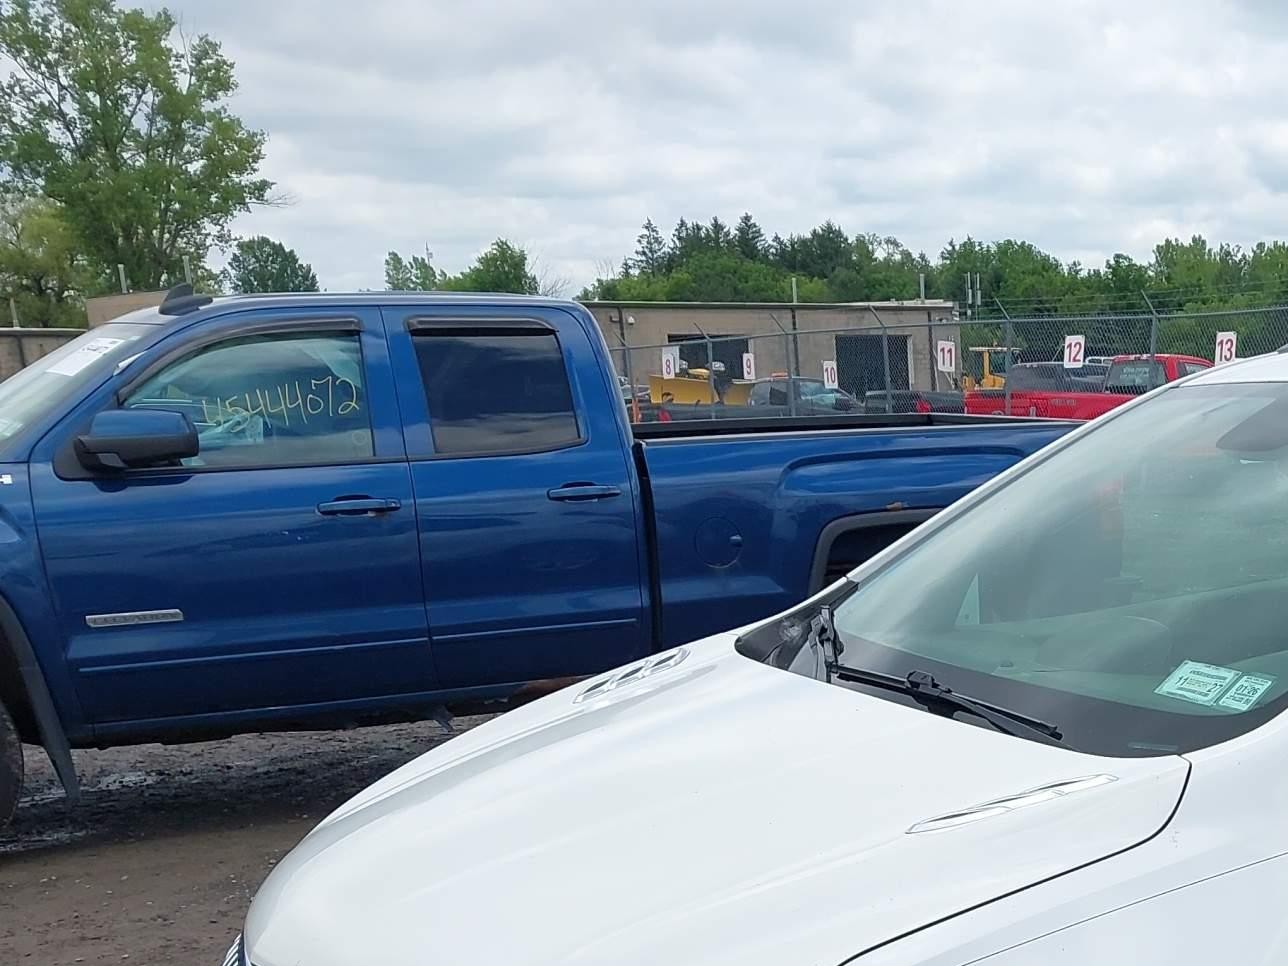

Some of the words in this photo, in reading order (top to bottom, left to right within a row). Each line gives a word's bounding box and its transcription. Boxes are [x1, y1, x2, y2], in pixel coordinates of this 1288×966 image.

[940, 347, 954, 368] 11
[1066, 341, 1082, 363] 12
[1217, 338, 1234, 362] 13
[665, 359, 671, 375] 8
[745, 358, 752, 376] 9
[824, 367, 836, 384] 10
[202, 375, 359, 433] 45444072
